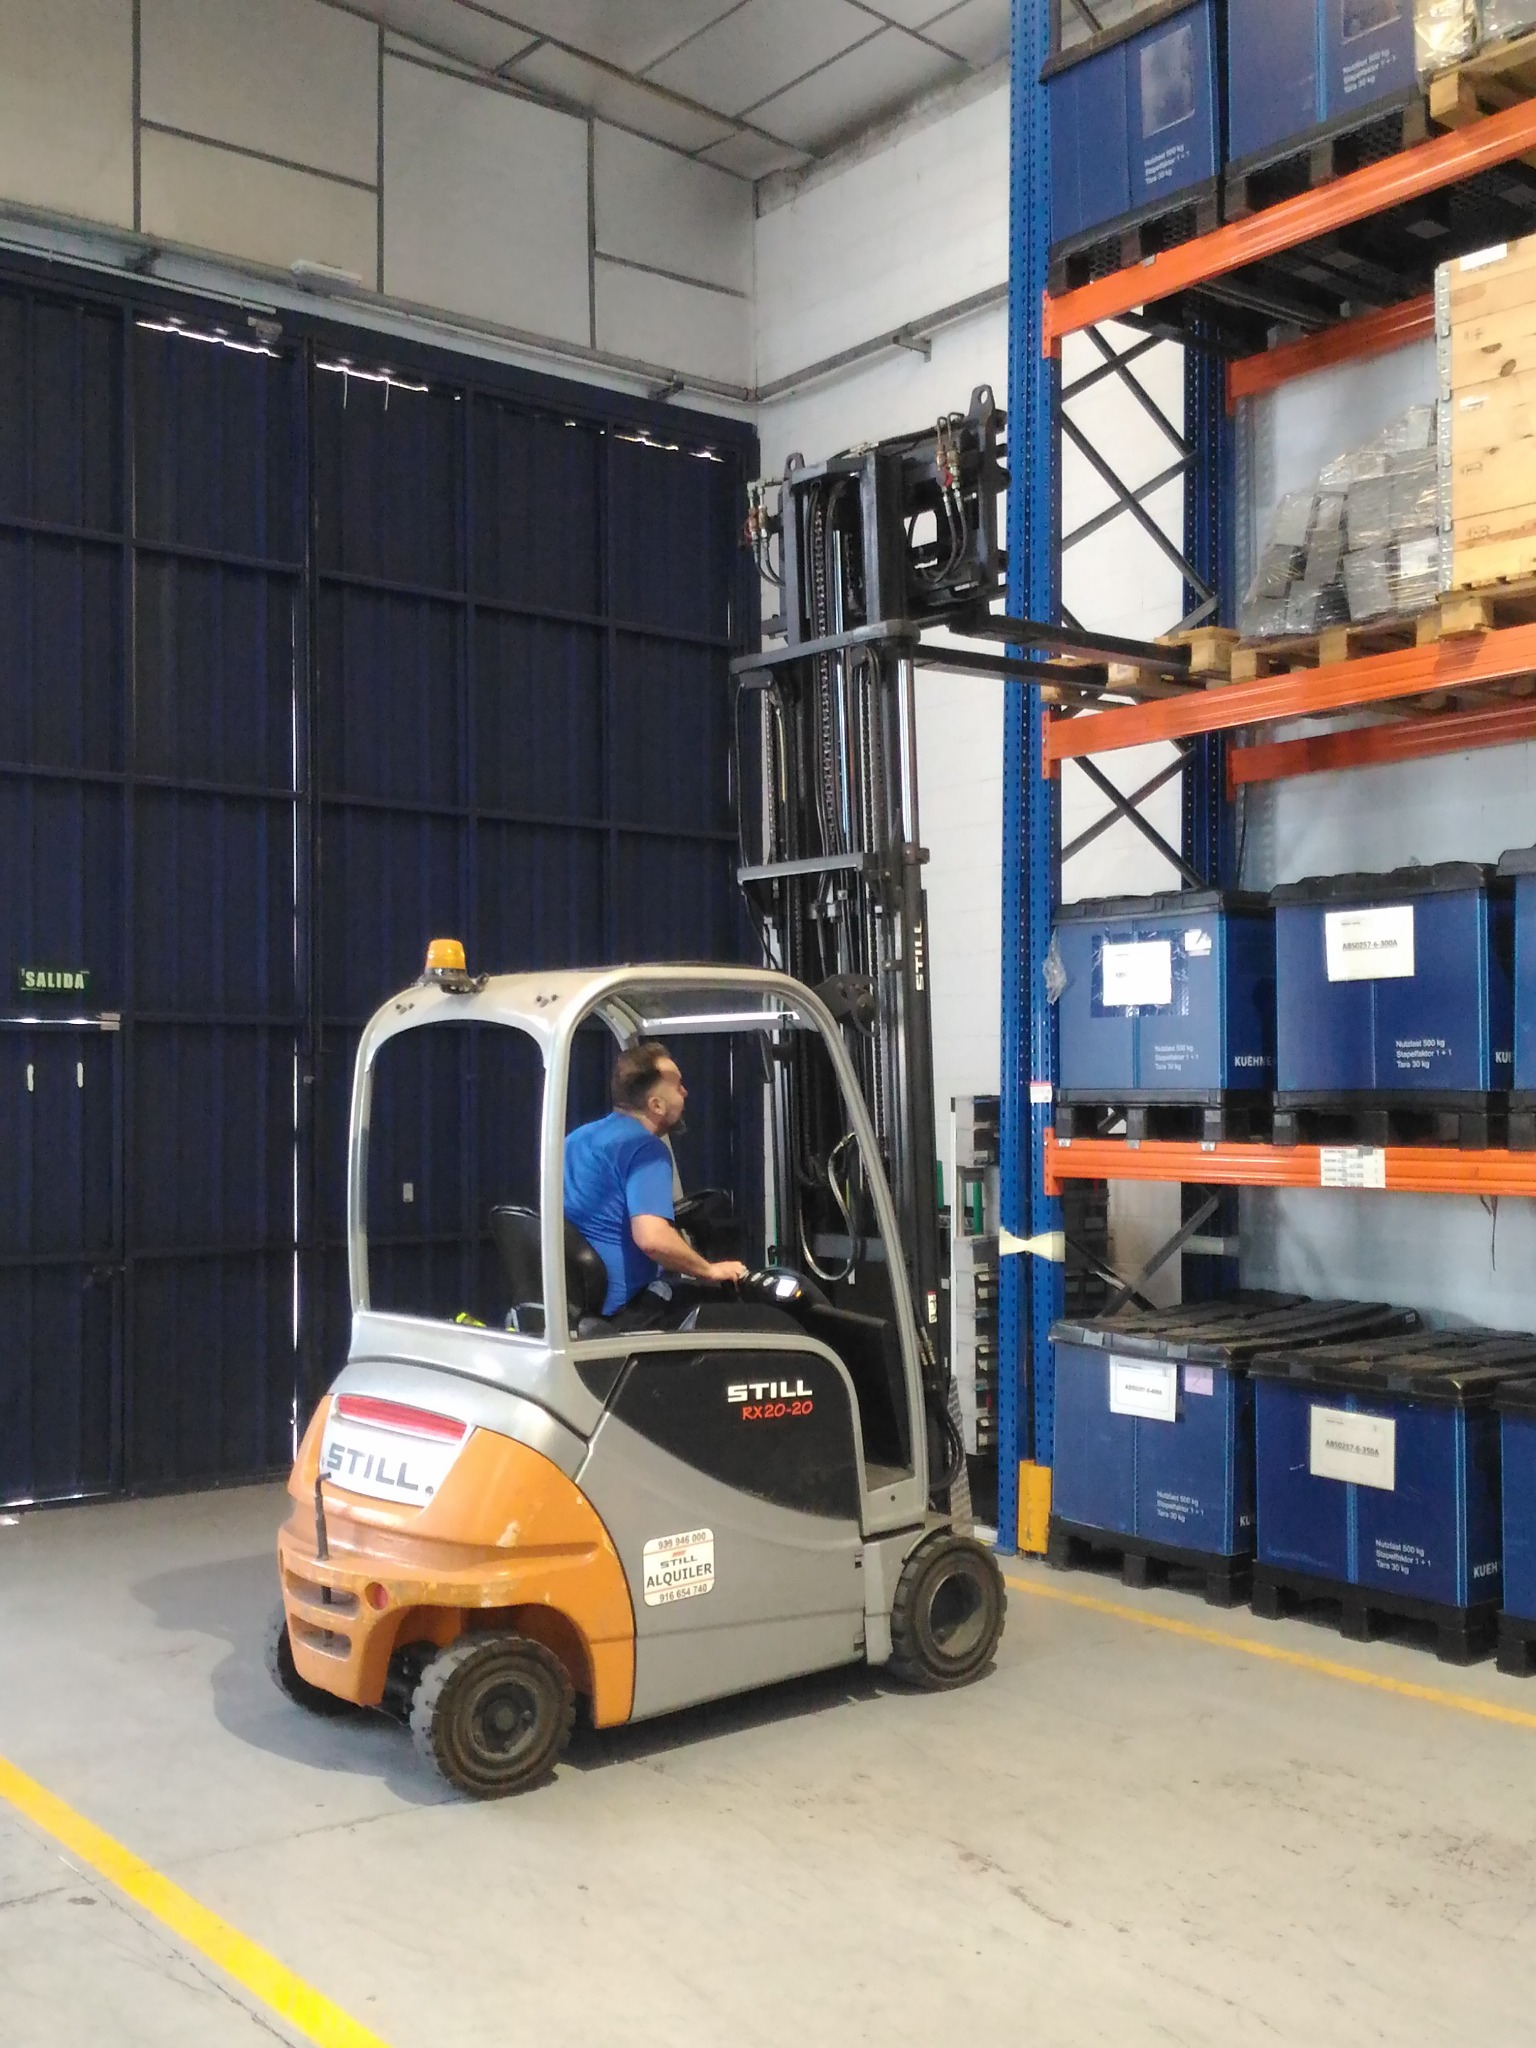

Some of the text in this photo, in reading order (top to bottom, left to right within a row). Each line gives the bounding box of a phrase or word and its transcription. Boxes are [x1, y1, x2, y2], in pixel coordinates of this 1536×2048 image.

[914, 918, 925, 991] STILL
[25, 971, 85, 989] SALIDA
[1422, 1039, 1435, 1047] 500
[1436, 1039, 1445, 1048] kg
[1396, 1060, 1430, 1069] Tara 30 kg
[728, 1380, 813, 1403] STILL
[742, 1400, 813, 1420] RX20-20
[327, 1442, 419, 1491] STILL
[675, 1535, 690, 1546] 946
[691, 1532, 706, 1542] 000
[1402, 1544, 1415, 1553] 500
[1416, 1548, 1425, 1557] kg
[660, 1555, 698, 1569] STILL
[1376, 1559, 1409, 1575] Tara 30 kg
[646, 1563, 713, 1588] ALQUILER
[660, 1583, 708, 1603] 916 654 740
